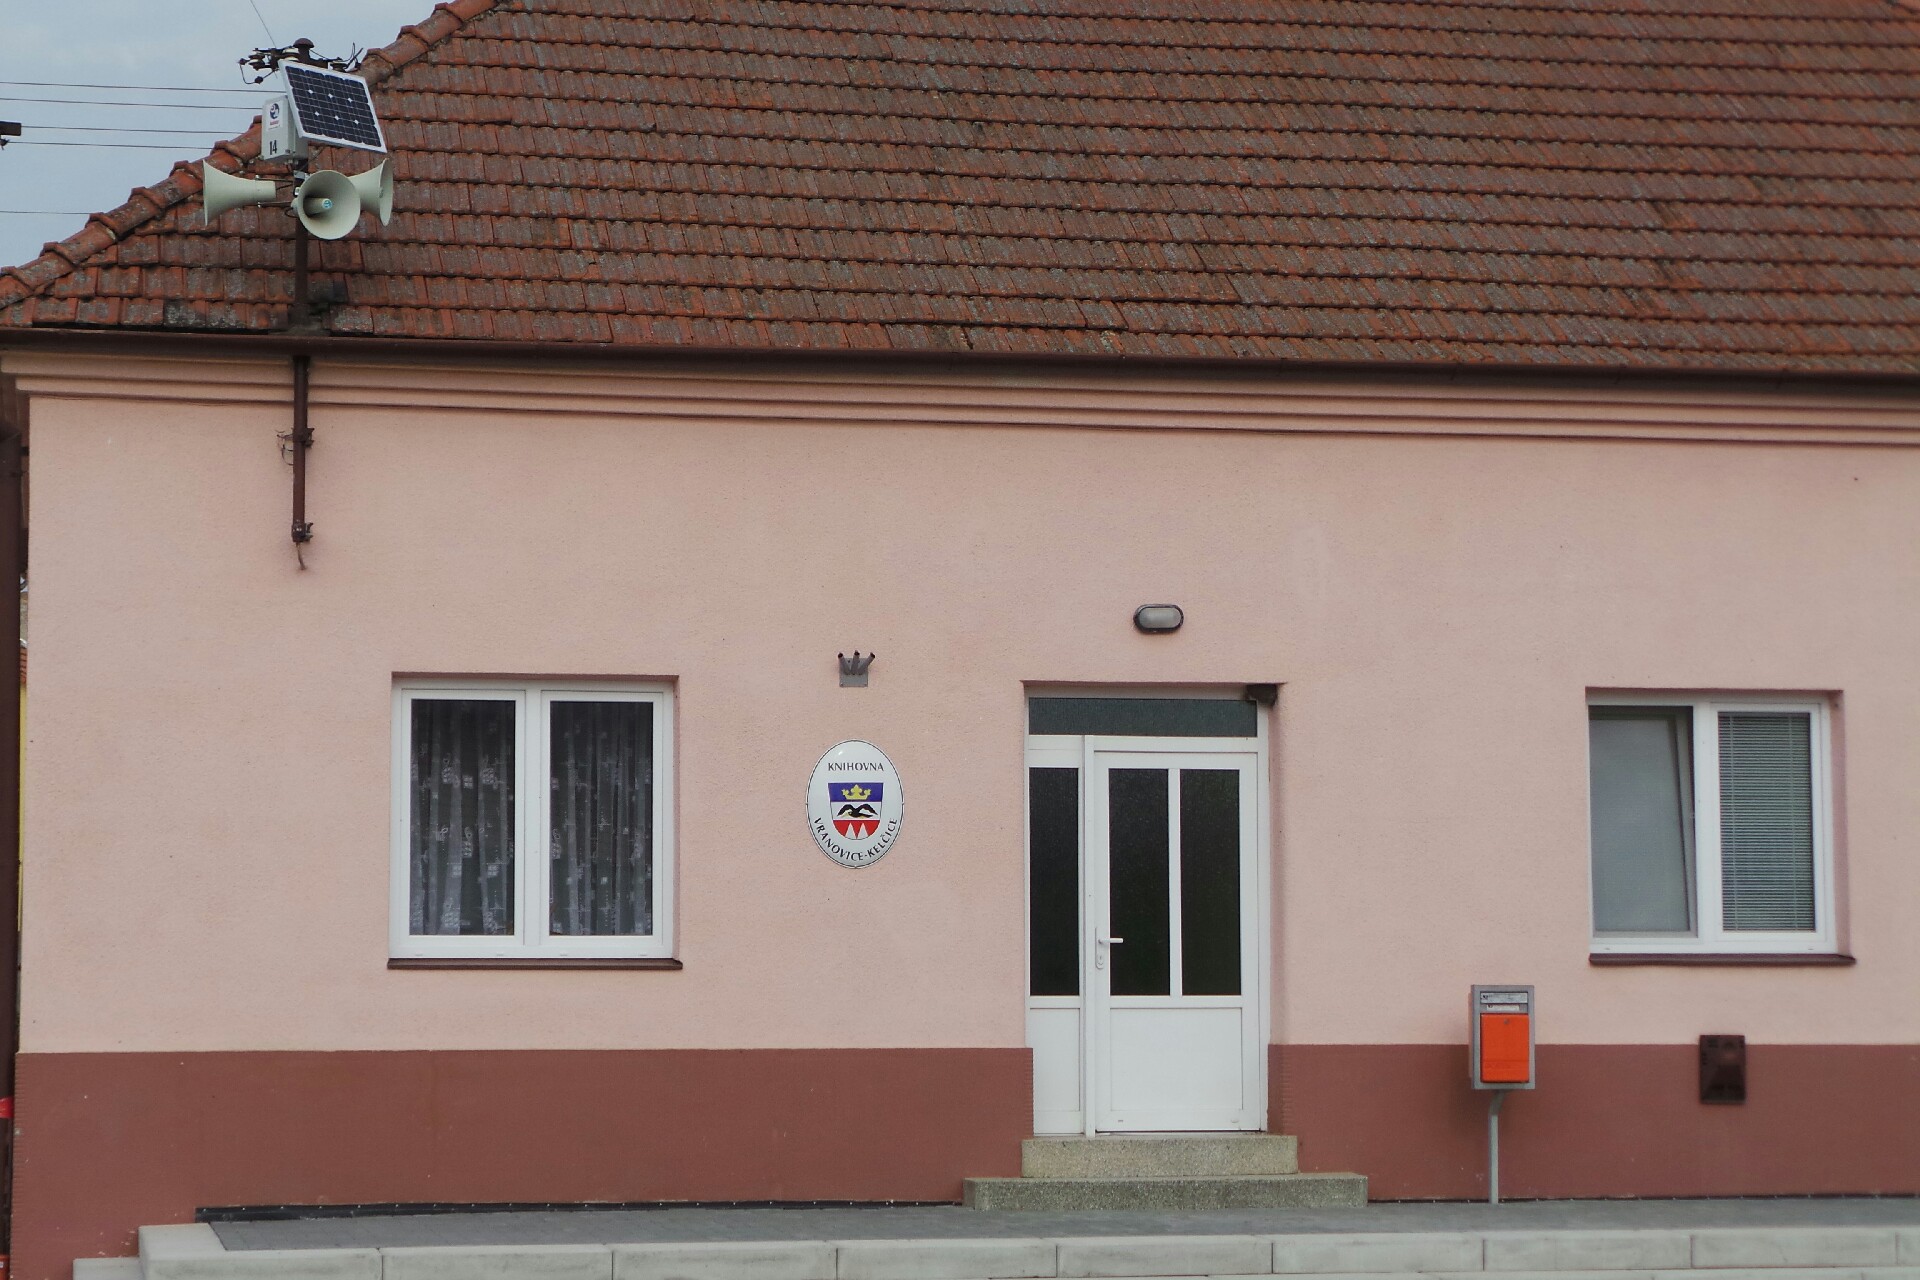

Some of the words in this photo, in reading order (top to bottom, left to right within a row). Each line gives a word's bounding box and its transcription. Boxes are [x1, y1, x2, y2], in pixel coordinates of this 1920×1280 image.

[269, 140, 277, 155] 14
[828, 762, 884, 771] KNIHOVNA
[814, 817, 897, 861] VRANOVICE-KELČICE
